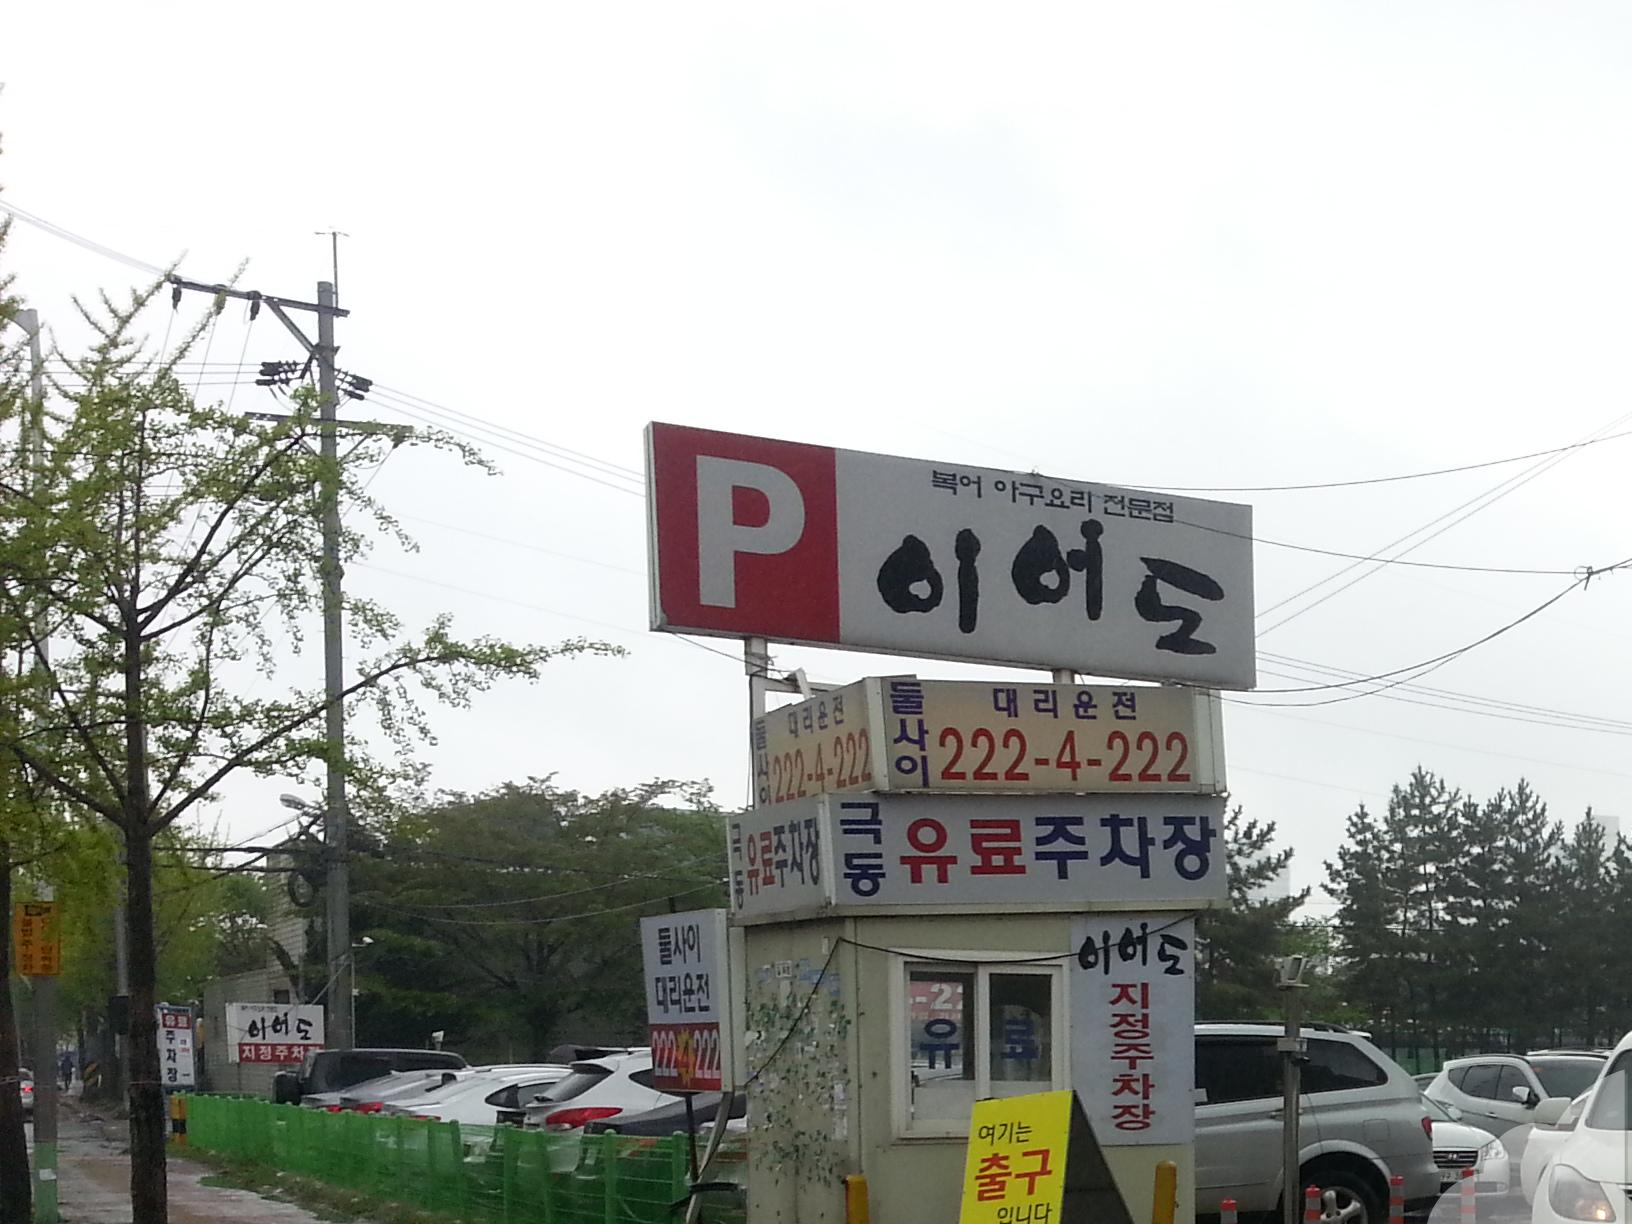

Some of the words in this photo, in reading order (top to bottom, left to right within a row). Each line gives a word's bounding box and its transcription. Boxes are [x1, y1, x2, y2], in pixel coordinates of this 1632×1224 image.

[932, 469, 983, 499] 복어
[994, 479, 1094, 514] 아구요리
[1103, 493, 1175, 524] 전문점
[696, 454, 806, 609] P
[876, 517, 1226, 657] 이어도
[788, 694, 845, 739] 대리운전
[992, 687, 1139, 722] 대리운전
[773, 727, 873, 804] 222-4-222
[938, 726, 1192, 784] 222-4-222
[747, 816, 821, 896] 유료주차장
[839, 801, 887, 898] 극동
[900, 814, 1220, 886] 유료주차장
[1078, 922, 1189, 976] 이어도
[654, 972, 711, 1014] 대리운전
[248, 1012, 314, 1041] 이어도
[1109, 982, 1156, 1131] 지정주차장
[978, 1121, 1033, 1147] 여기는
[974, 1148, 1053, 1202] 출구
